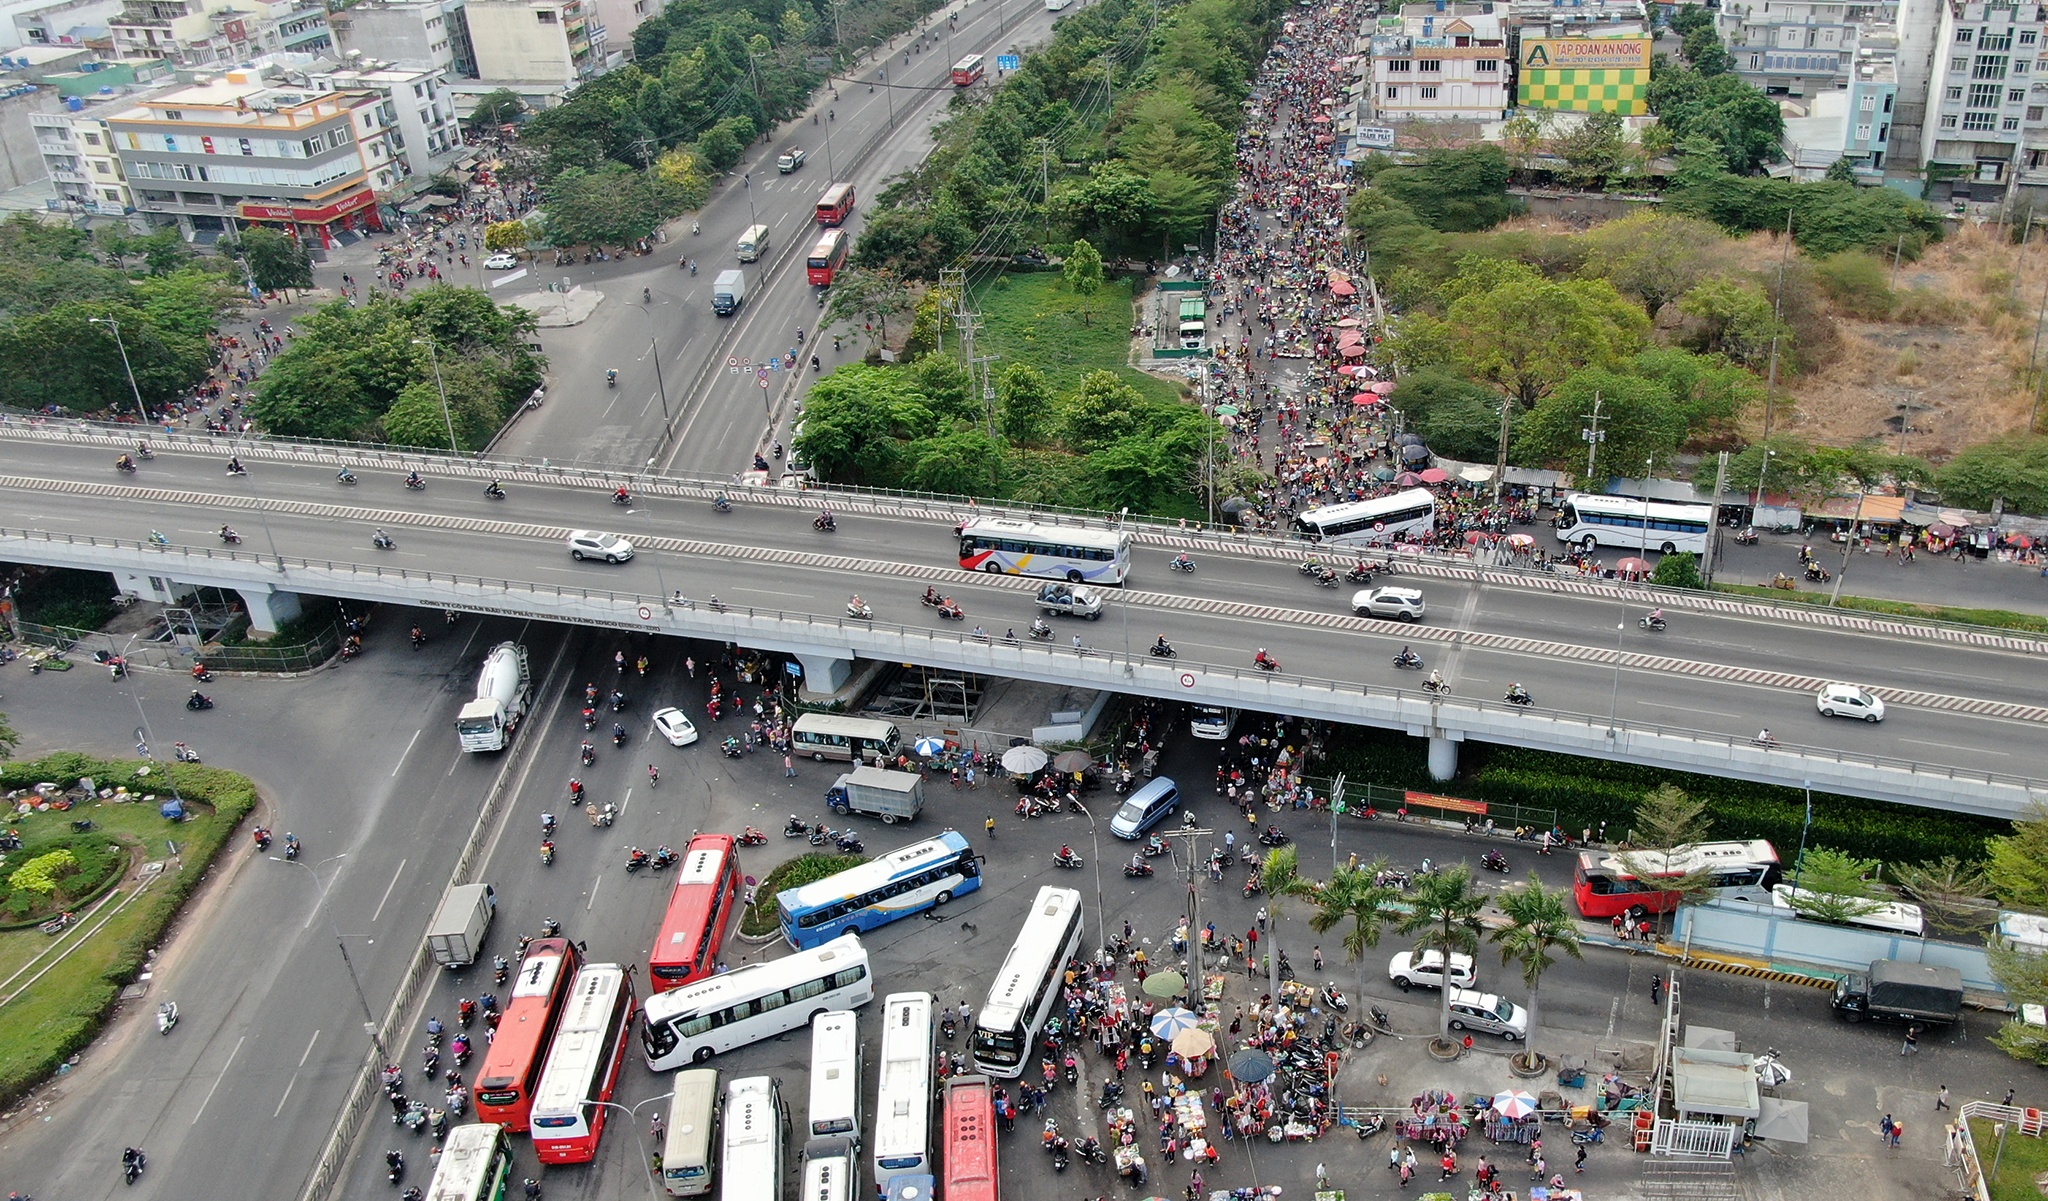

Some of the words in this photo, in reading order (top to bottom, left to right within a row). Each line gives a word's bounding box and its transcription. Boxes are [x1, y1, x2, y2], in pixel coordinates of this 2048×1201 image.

[1602, 44, 1614, 54] AN
[1616, 40, 1642, 54] NÔNG
[978, 1030, 994, 1038] VIP
